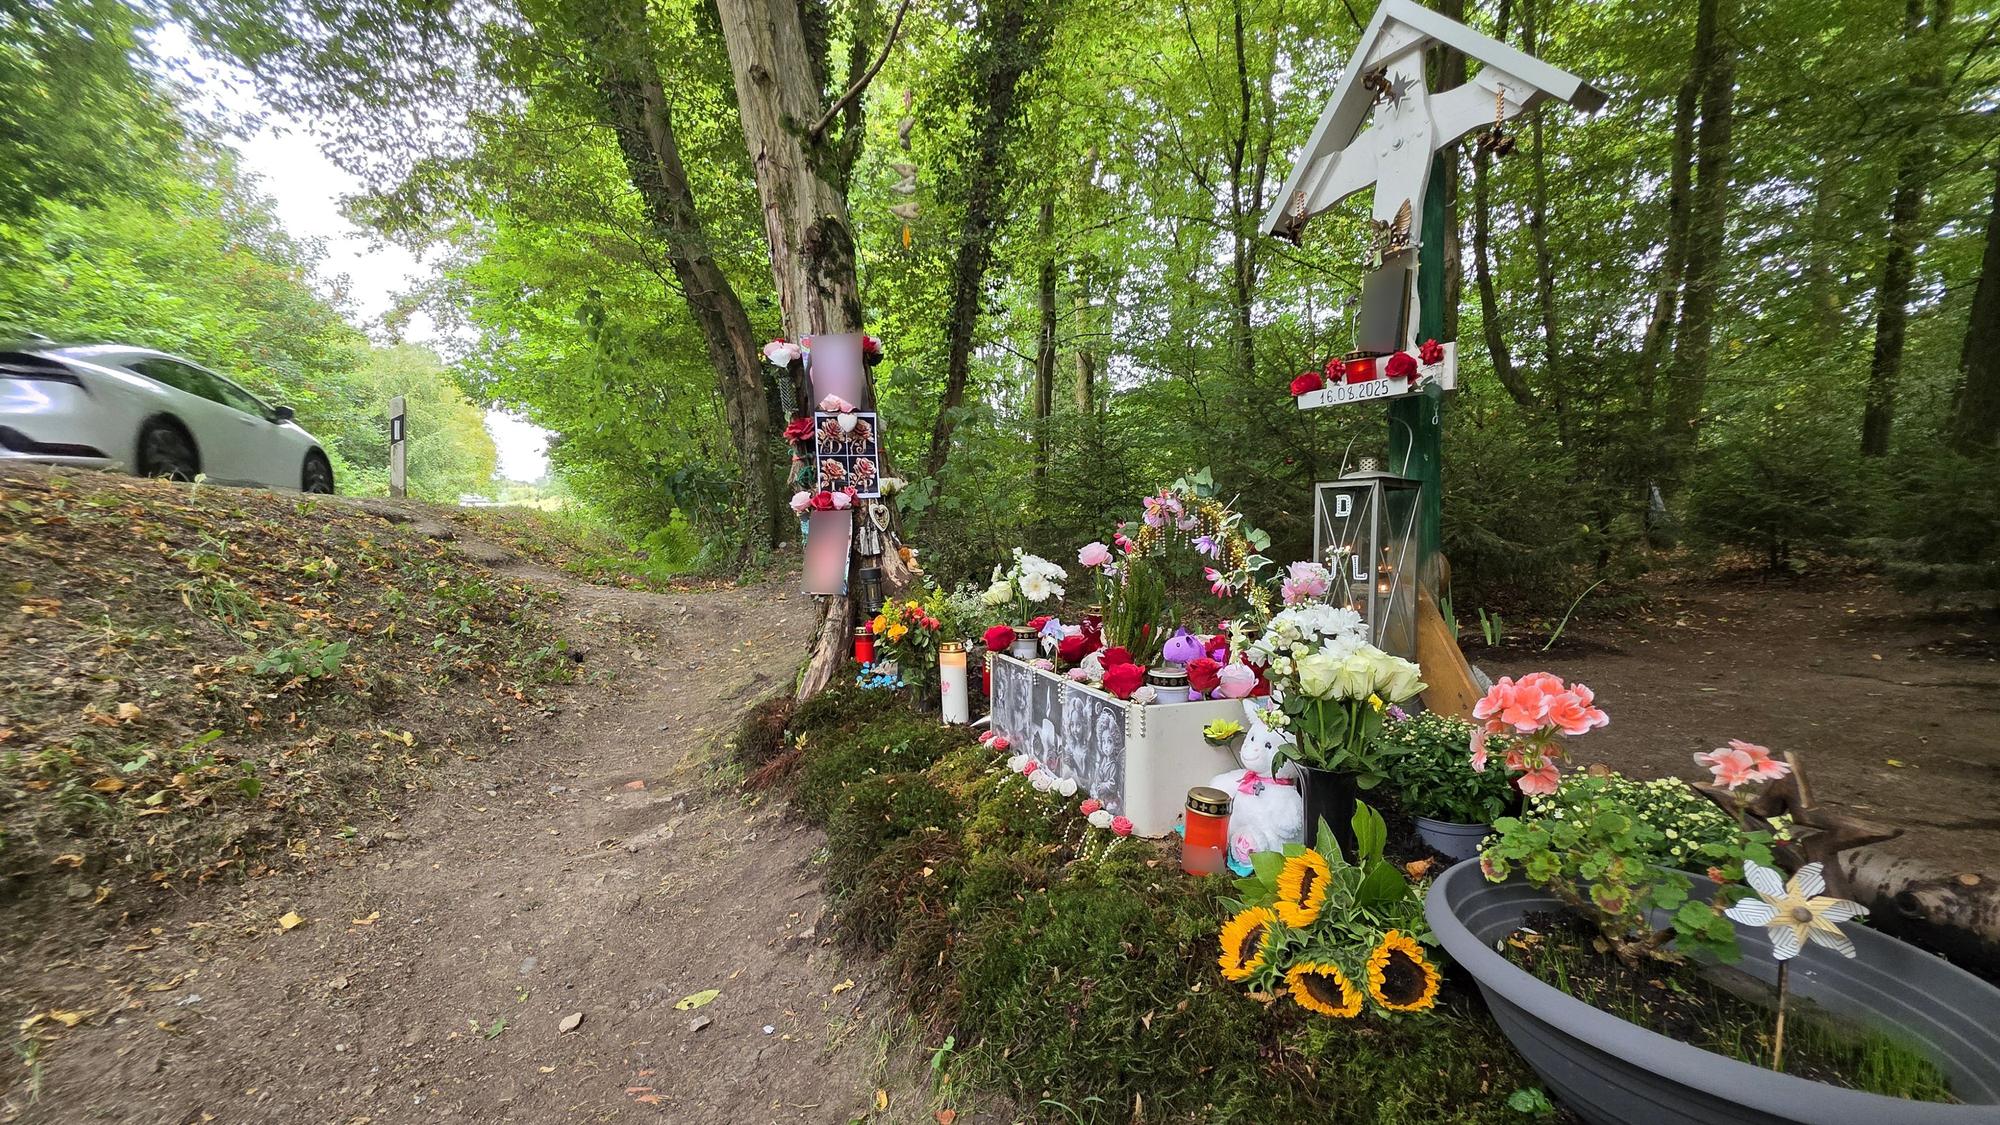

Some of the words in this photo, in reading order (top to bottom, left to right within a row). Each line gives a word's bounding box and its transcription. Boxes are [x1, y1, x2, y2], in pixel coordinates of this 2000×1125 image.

[1320, 380, 1389, 404] 16.08.2025
[1335, 494, 1352, 518] D
[1351, 554, 1368, 580] L
